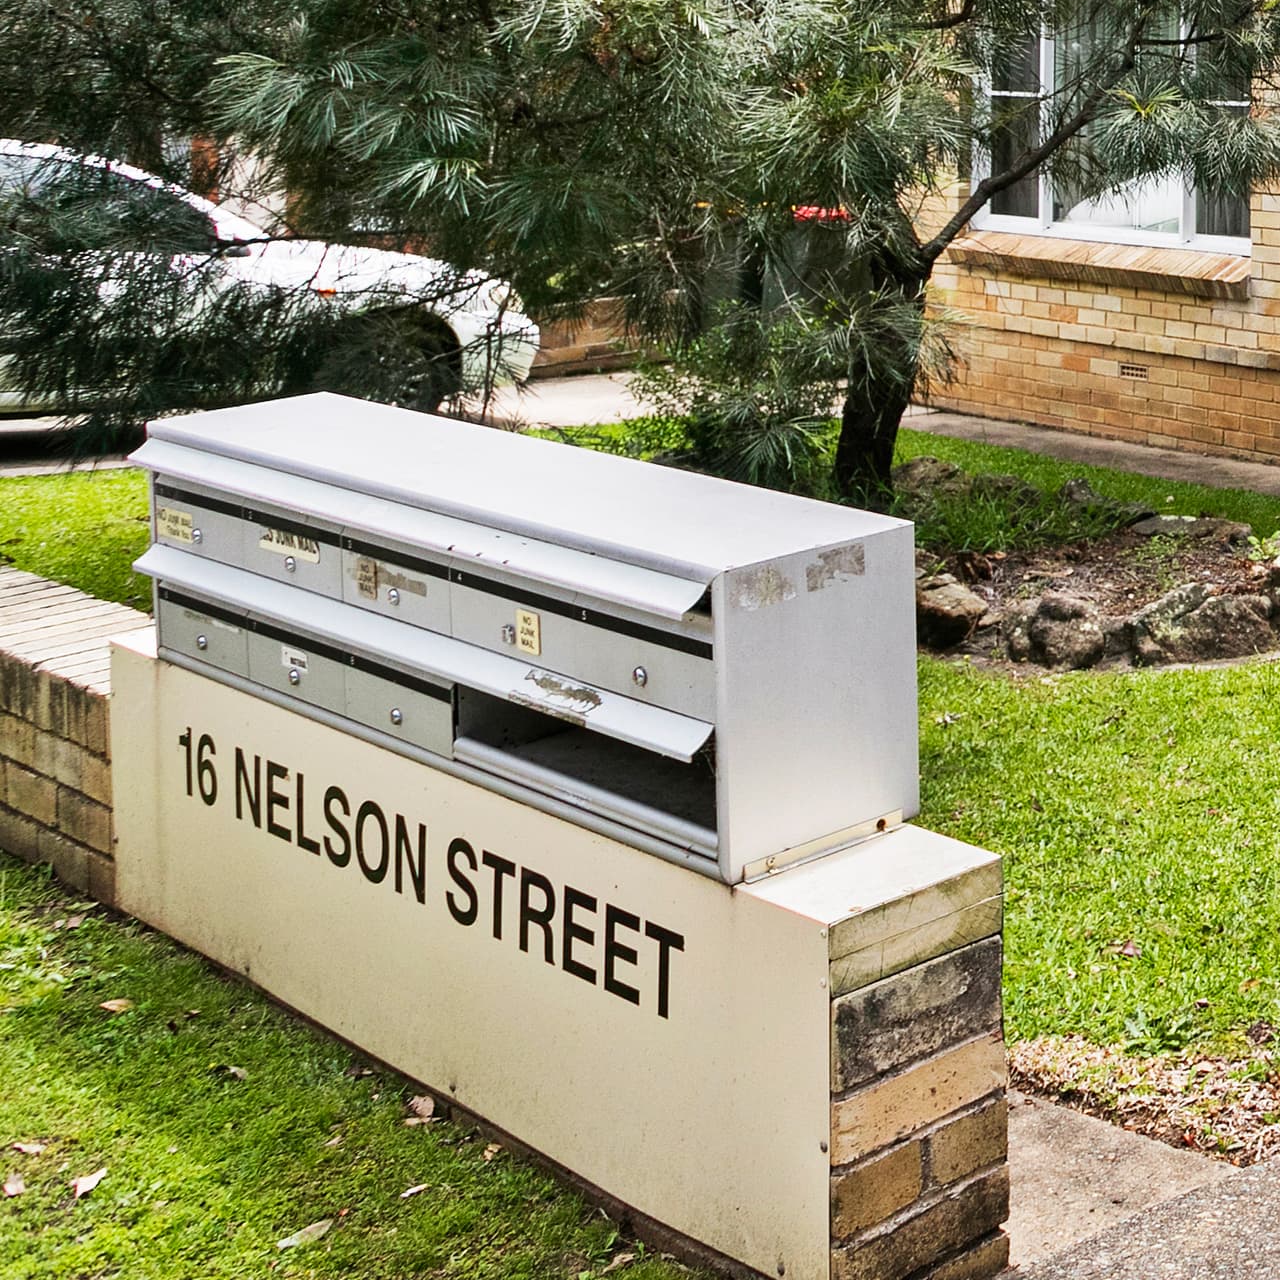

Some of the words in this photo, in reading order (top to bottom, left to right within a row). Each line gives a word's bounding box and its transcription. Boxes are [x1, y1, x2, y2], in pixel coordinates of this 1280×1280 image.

[522, 616, 532, 626] NO
[520, 627, 535, 638] JUNK
[521, 638, 535, 650] MAIL
[178, 726, 218, 806] 16
[235, 746, 427, 905] NELSON
[446, 837, 685, 1019] STREET
